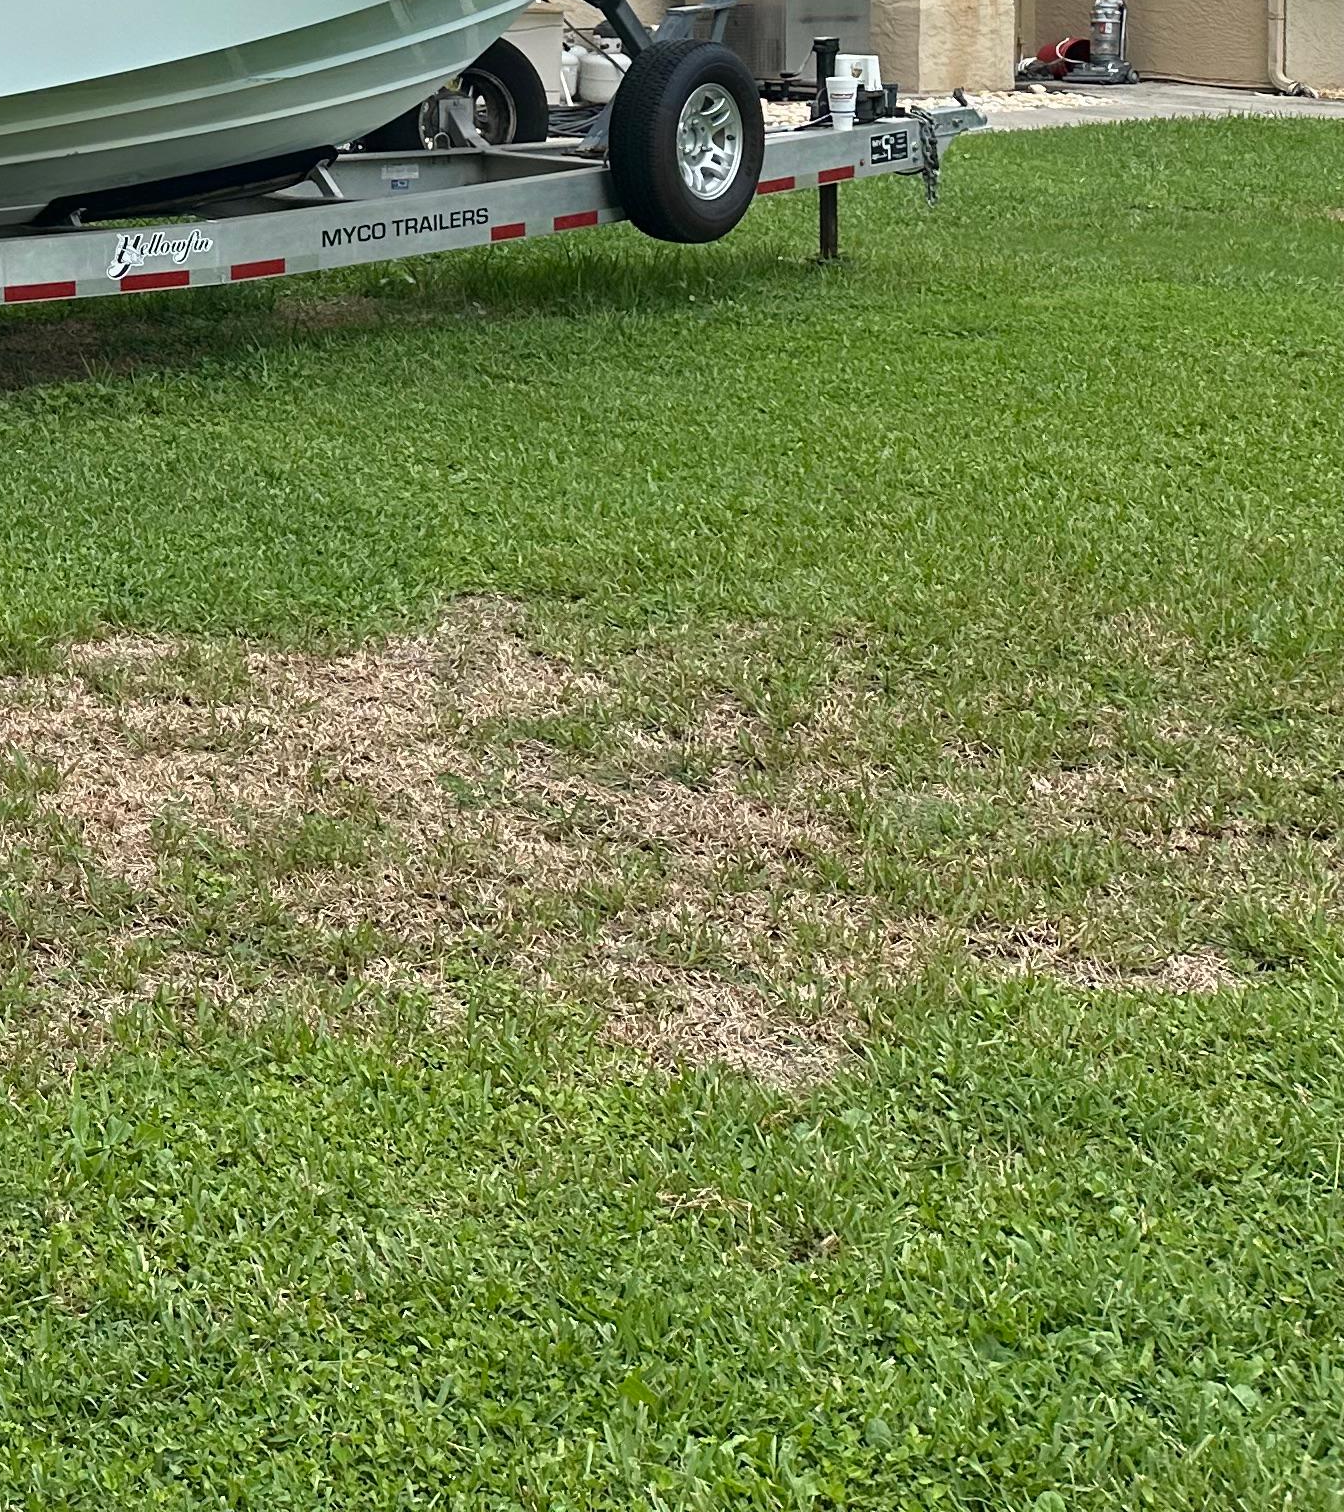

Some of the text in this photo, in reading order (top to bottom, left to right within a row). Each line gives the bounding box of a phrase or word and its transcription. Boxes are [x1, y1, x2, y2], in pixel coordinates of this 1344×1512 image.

[321, 207, 490, 248] MYCO TRAILERS
[107, 229, 212, 279] Yellowfin
